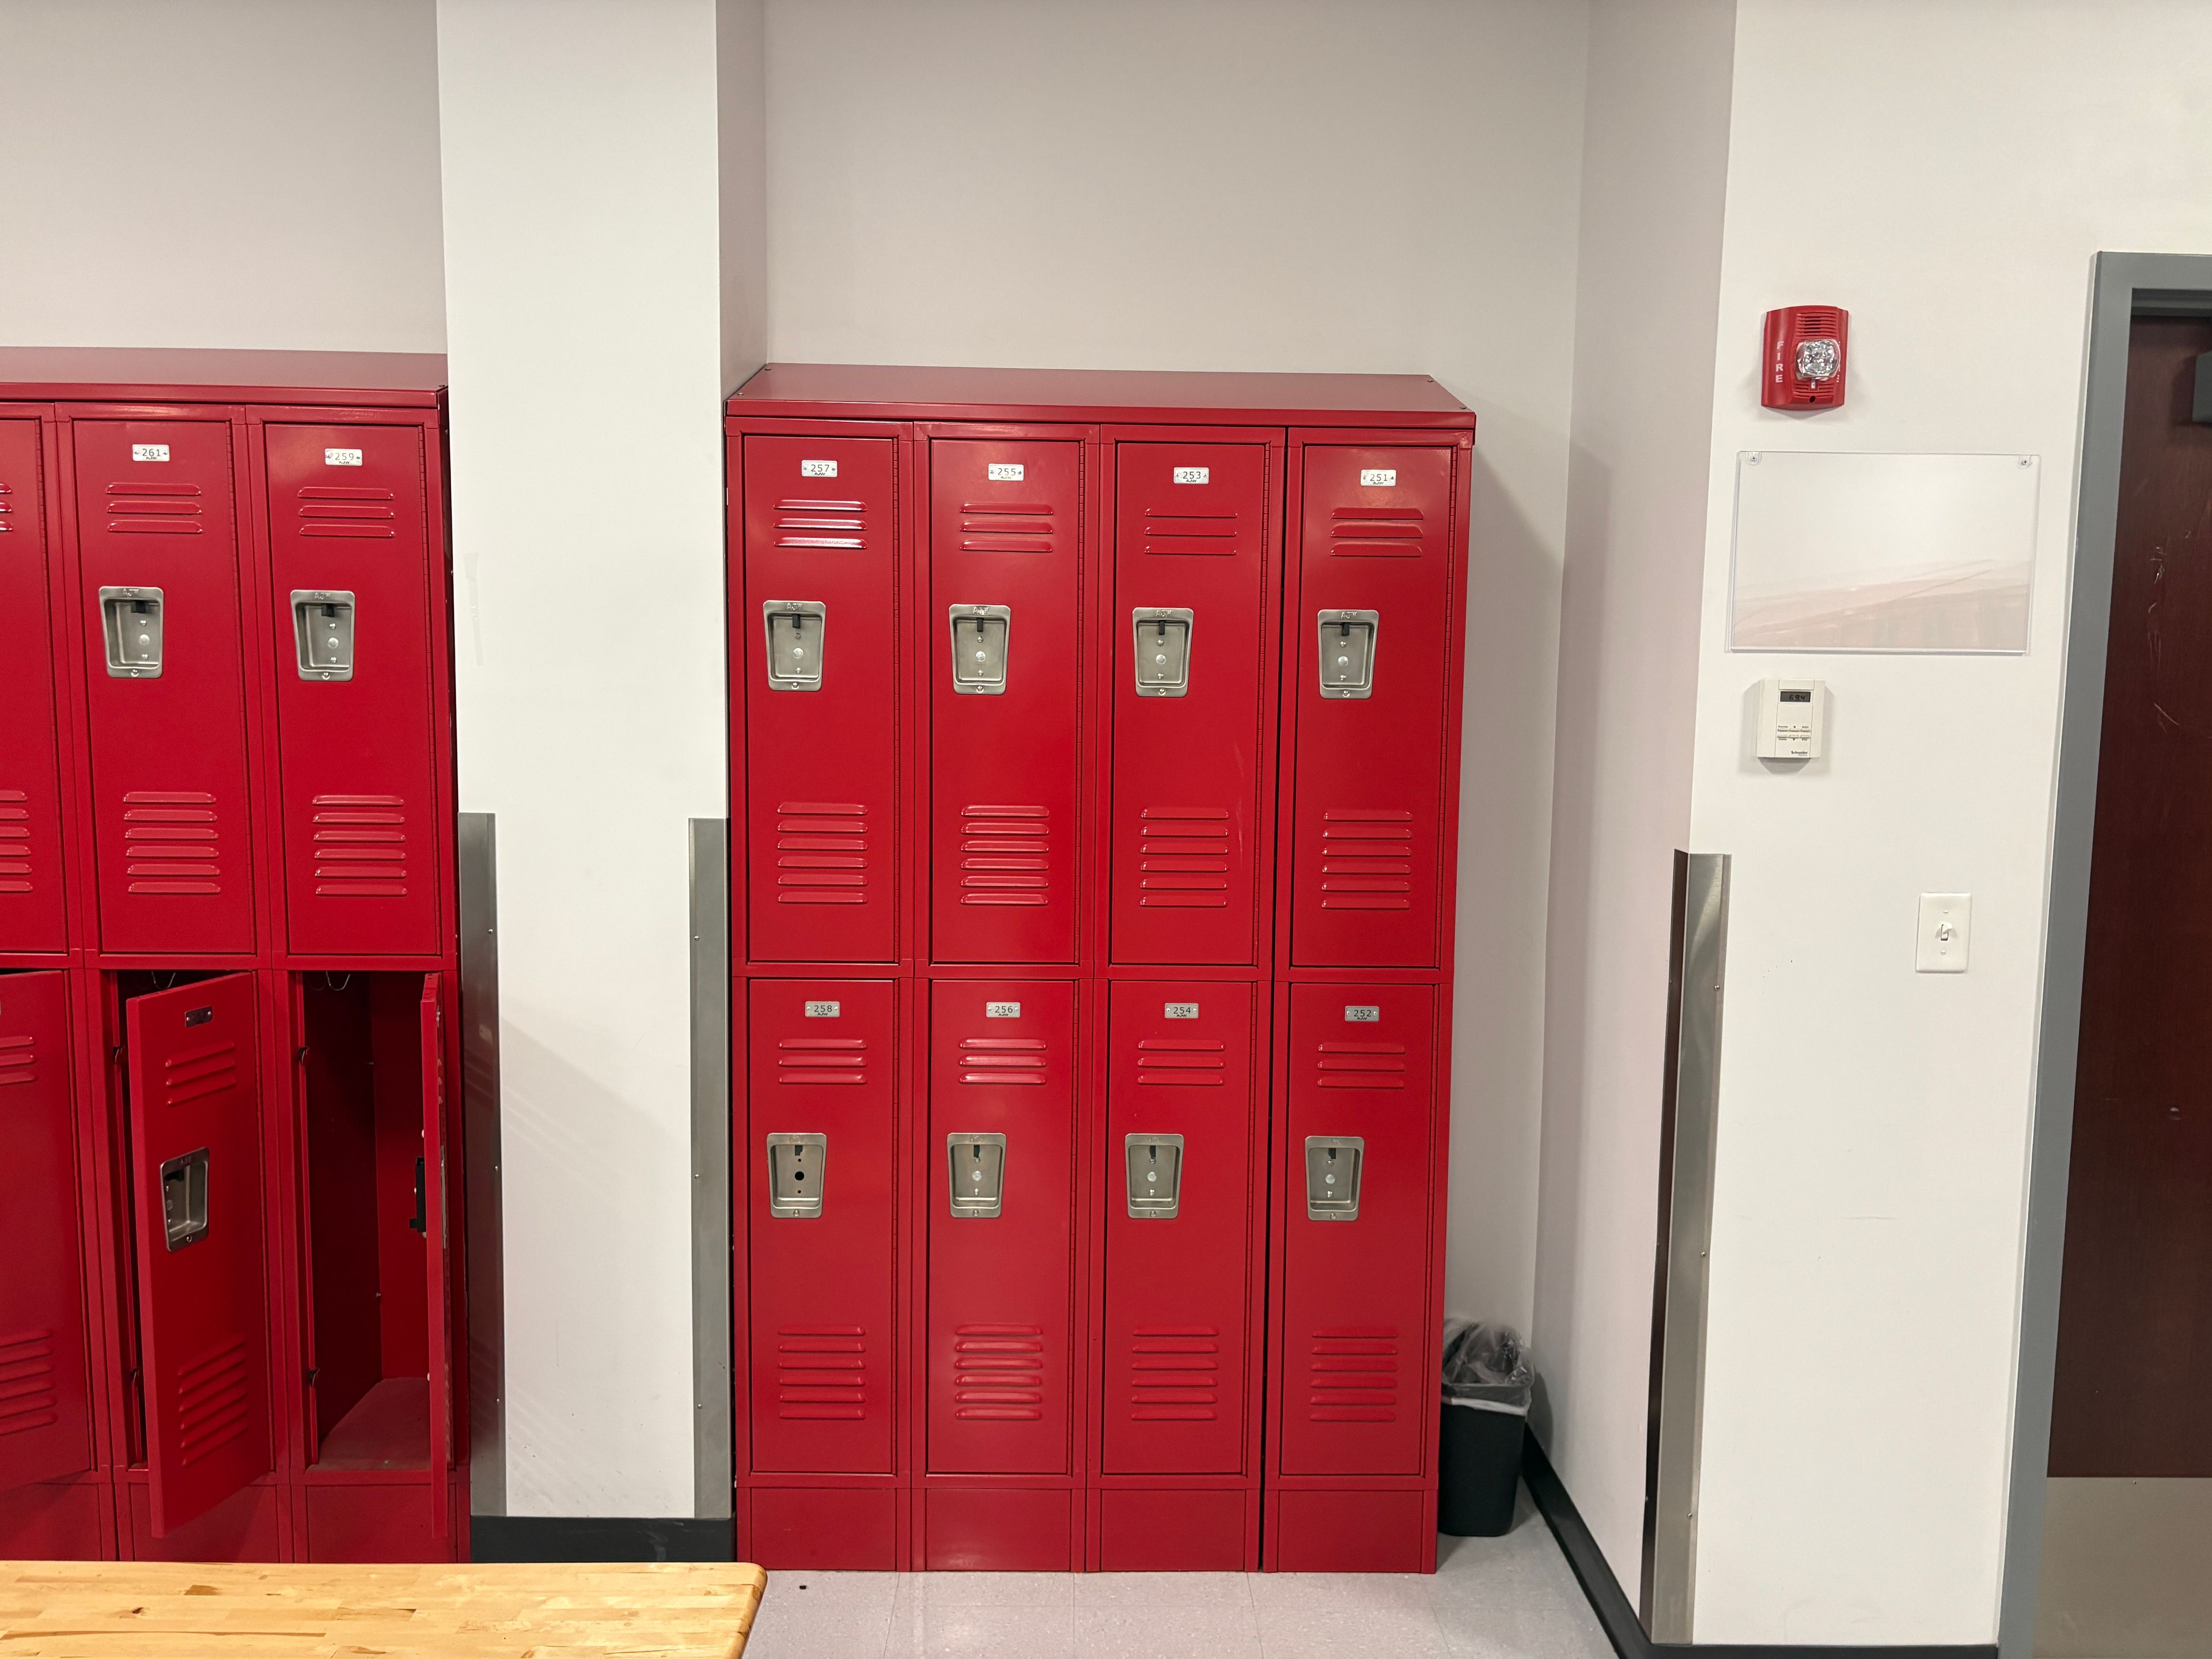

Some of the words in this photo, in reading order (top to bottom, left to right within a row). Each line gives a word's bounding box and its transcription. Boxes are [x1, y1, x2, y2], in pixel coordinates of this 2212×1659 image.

[1775, 340, 1784, 383] FIRE
[142, 448, 161, 456] 261
[997, 468, 1016, 476] 255
[1370, 474, 1388, 482] 251
